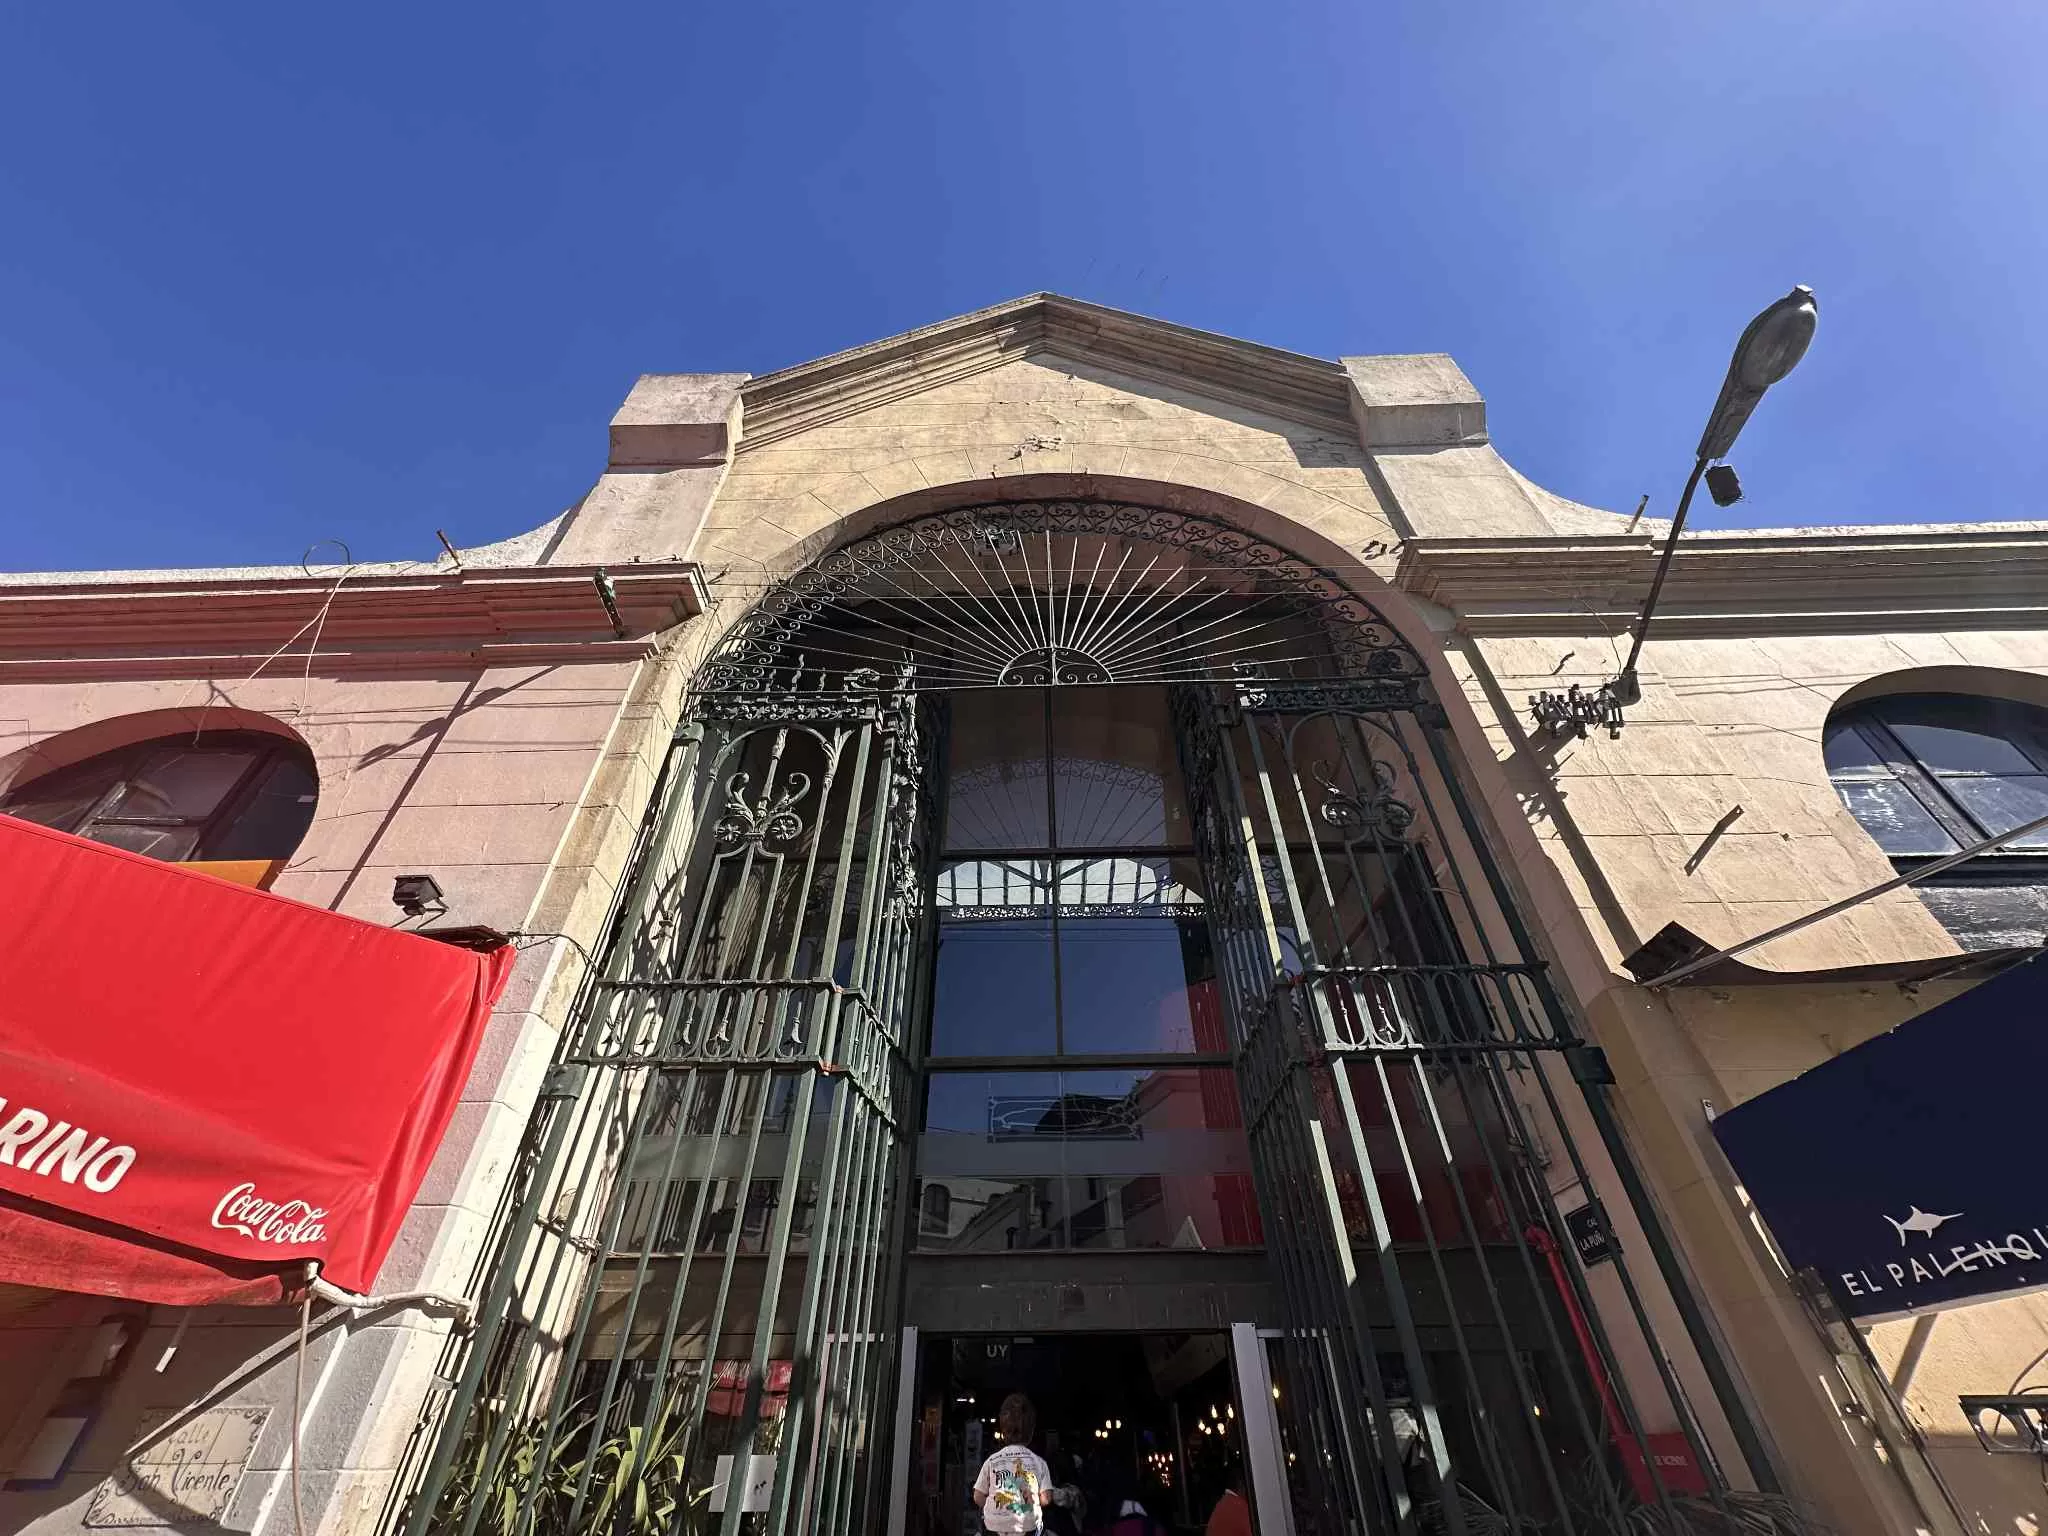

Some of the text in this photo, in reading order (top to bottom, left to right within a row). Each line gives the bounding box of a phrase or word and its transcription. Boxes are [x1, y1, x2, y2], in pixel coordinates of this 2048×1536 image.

[0, 1096, 137, 1193] RINO
[211, 1182, 328, 1243] Coca-Cola
[1841, 1270, 1884, 1296] EL
[170, 1448, 231, 1504] Vicente
